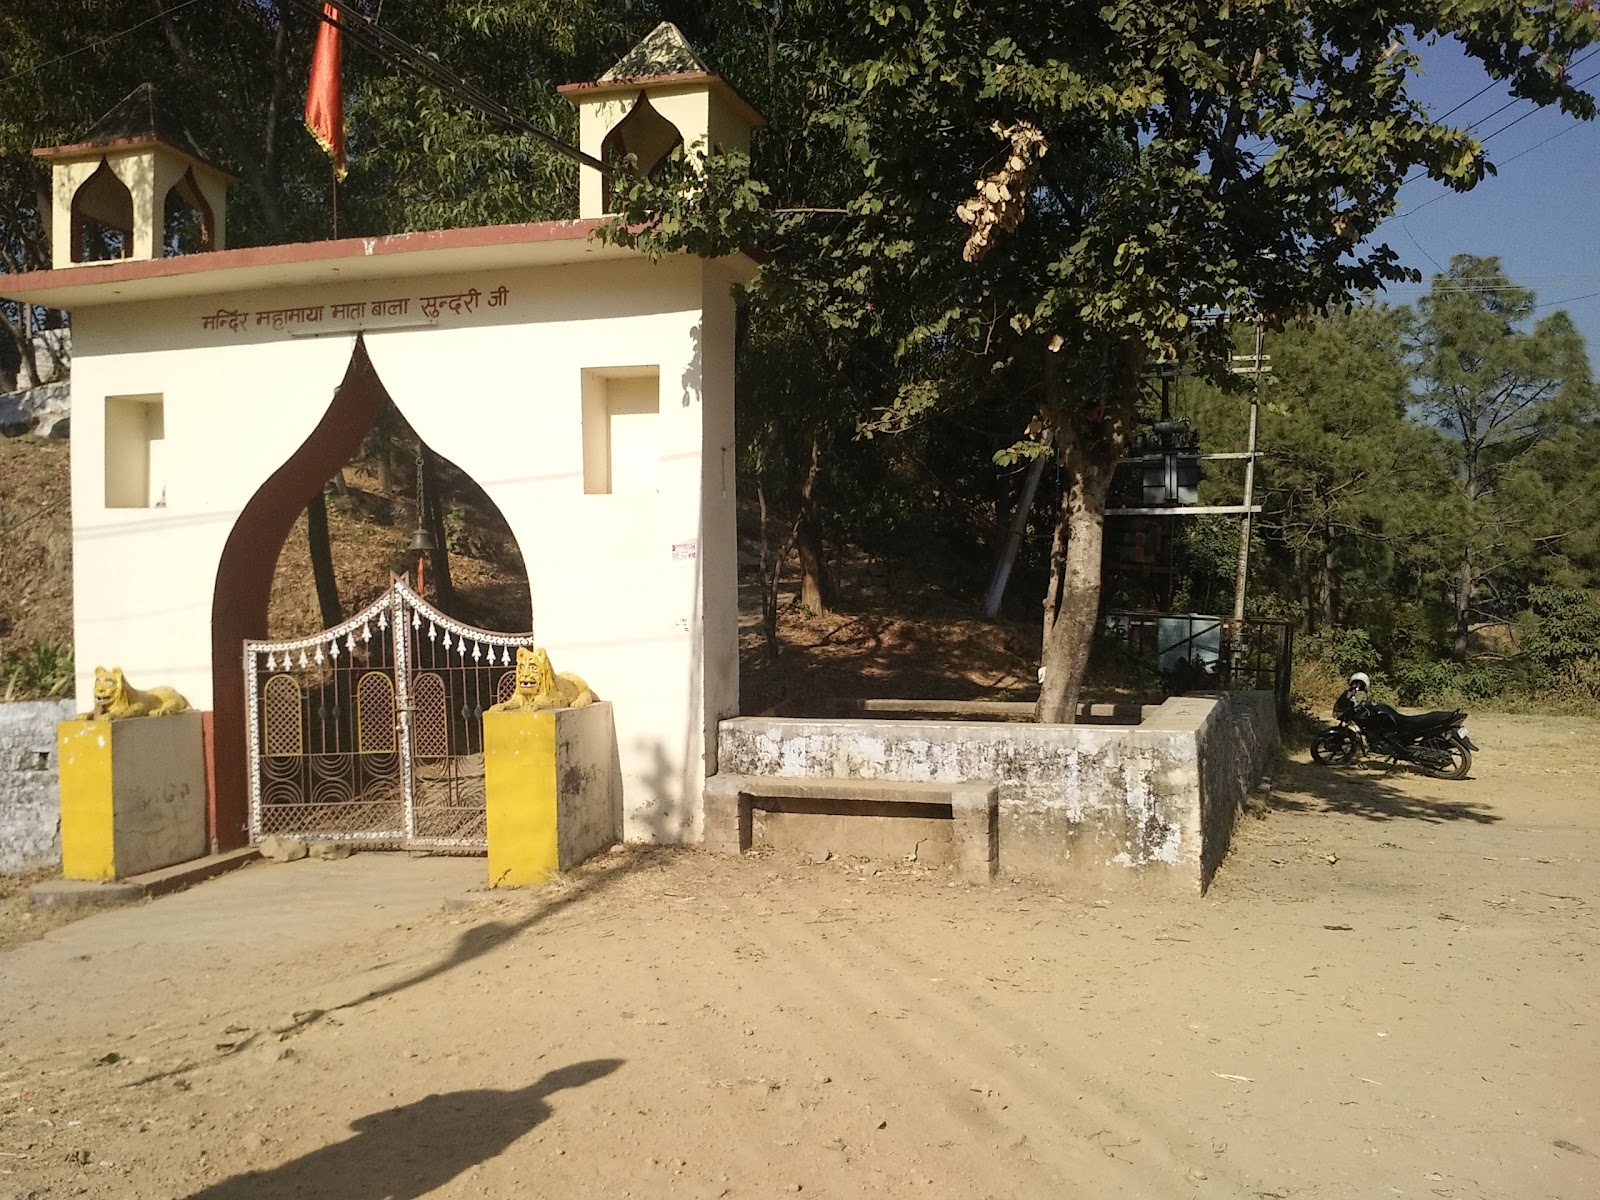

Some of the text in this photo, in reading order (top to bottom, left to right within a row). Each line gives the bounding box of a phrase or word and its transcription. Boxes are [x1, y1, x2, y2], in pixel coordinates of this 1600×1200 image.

[255, 306, 325, 331] महामाया
[330, 302, 366, 320] माता
[371, 299, 410, 317] बाला
[420, 288, 482, 318] सुन्दरी
[487, 285, 509, 307] जी
